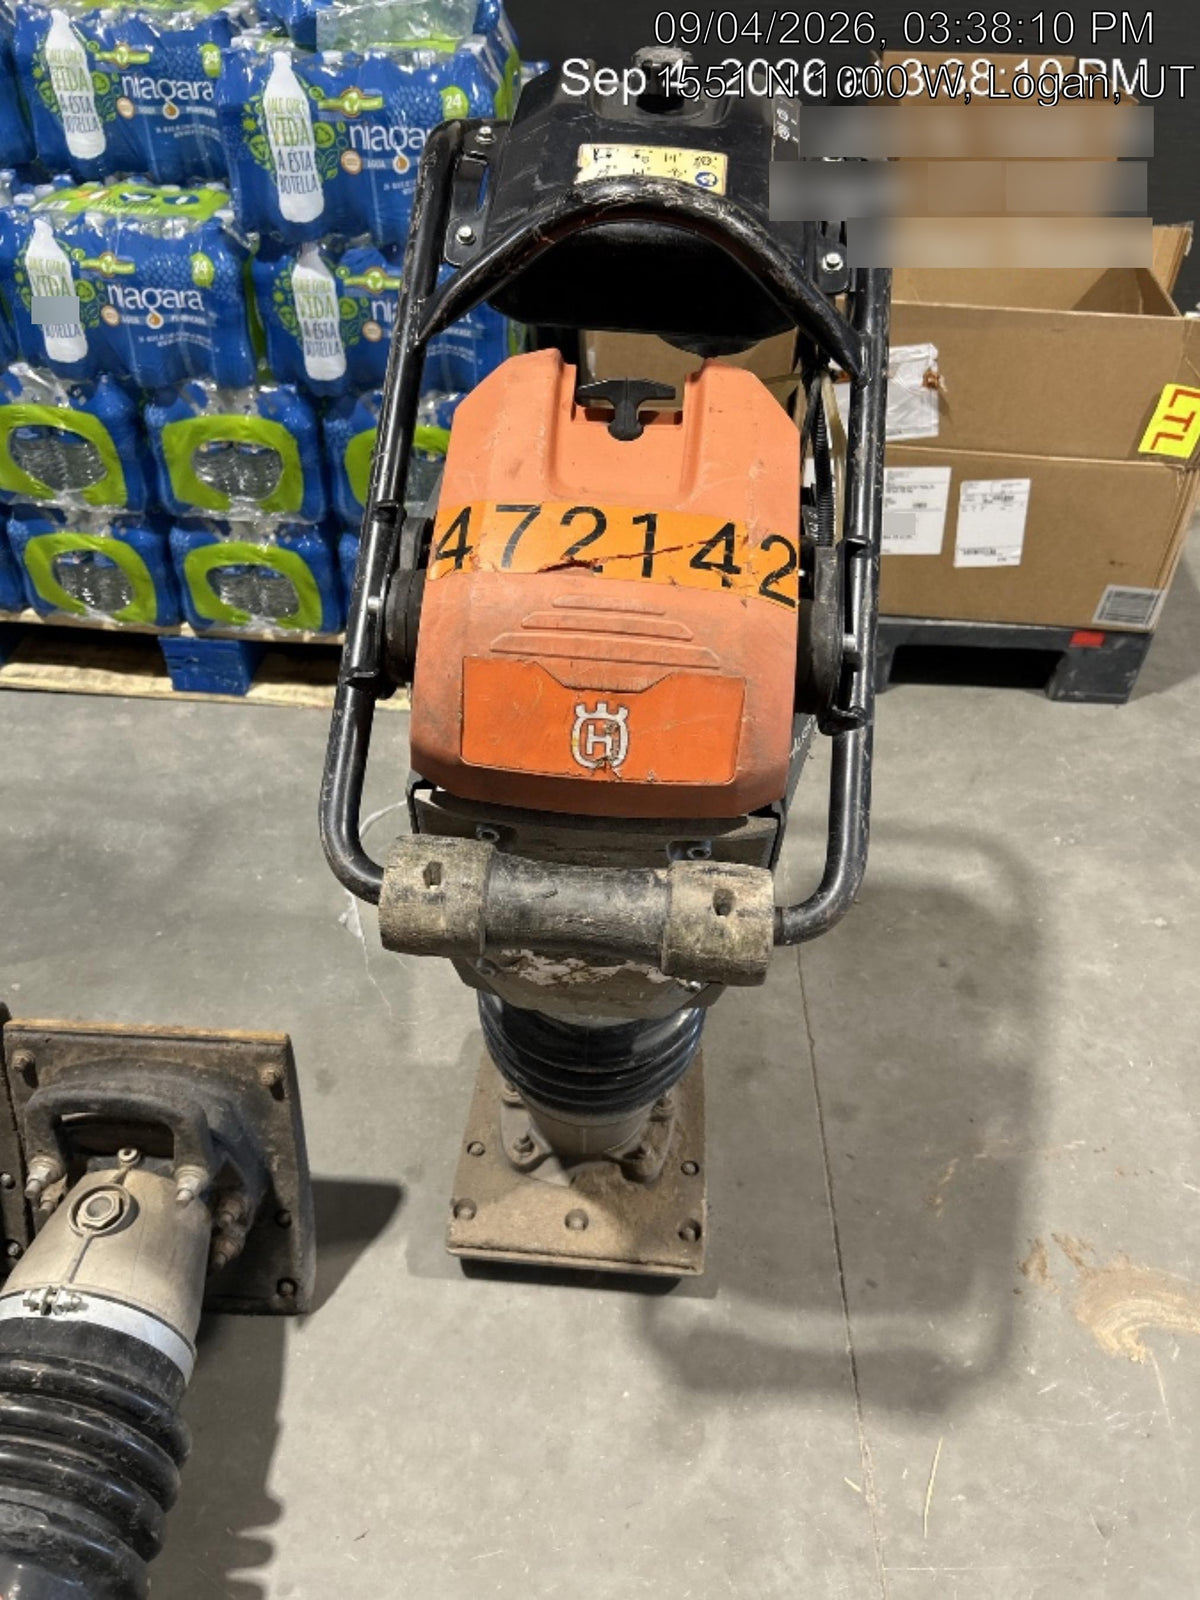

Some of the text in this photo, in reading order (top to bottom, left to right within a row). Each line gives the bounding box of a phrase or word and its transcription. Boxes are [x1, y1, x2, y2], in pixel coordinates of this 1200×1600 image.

[204, 51, 218, 64] 24
[121, 75, 214, 110] niagara
[444, 94, 462, 109] 24
[269, 116, 311, 146] VIDA
[278, 147, 286, 172] A
[280, 174, 319, 194] BOTELLA
[193, 260, 208, 274] 24
[107, 285, 205, 319] niagara
[1150, 389, 1200, 450] LTL
[435, 504, 798, 608] 472142
